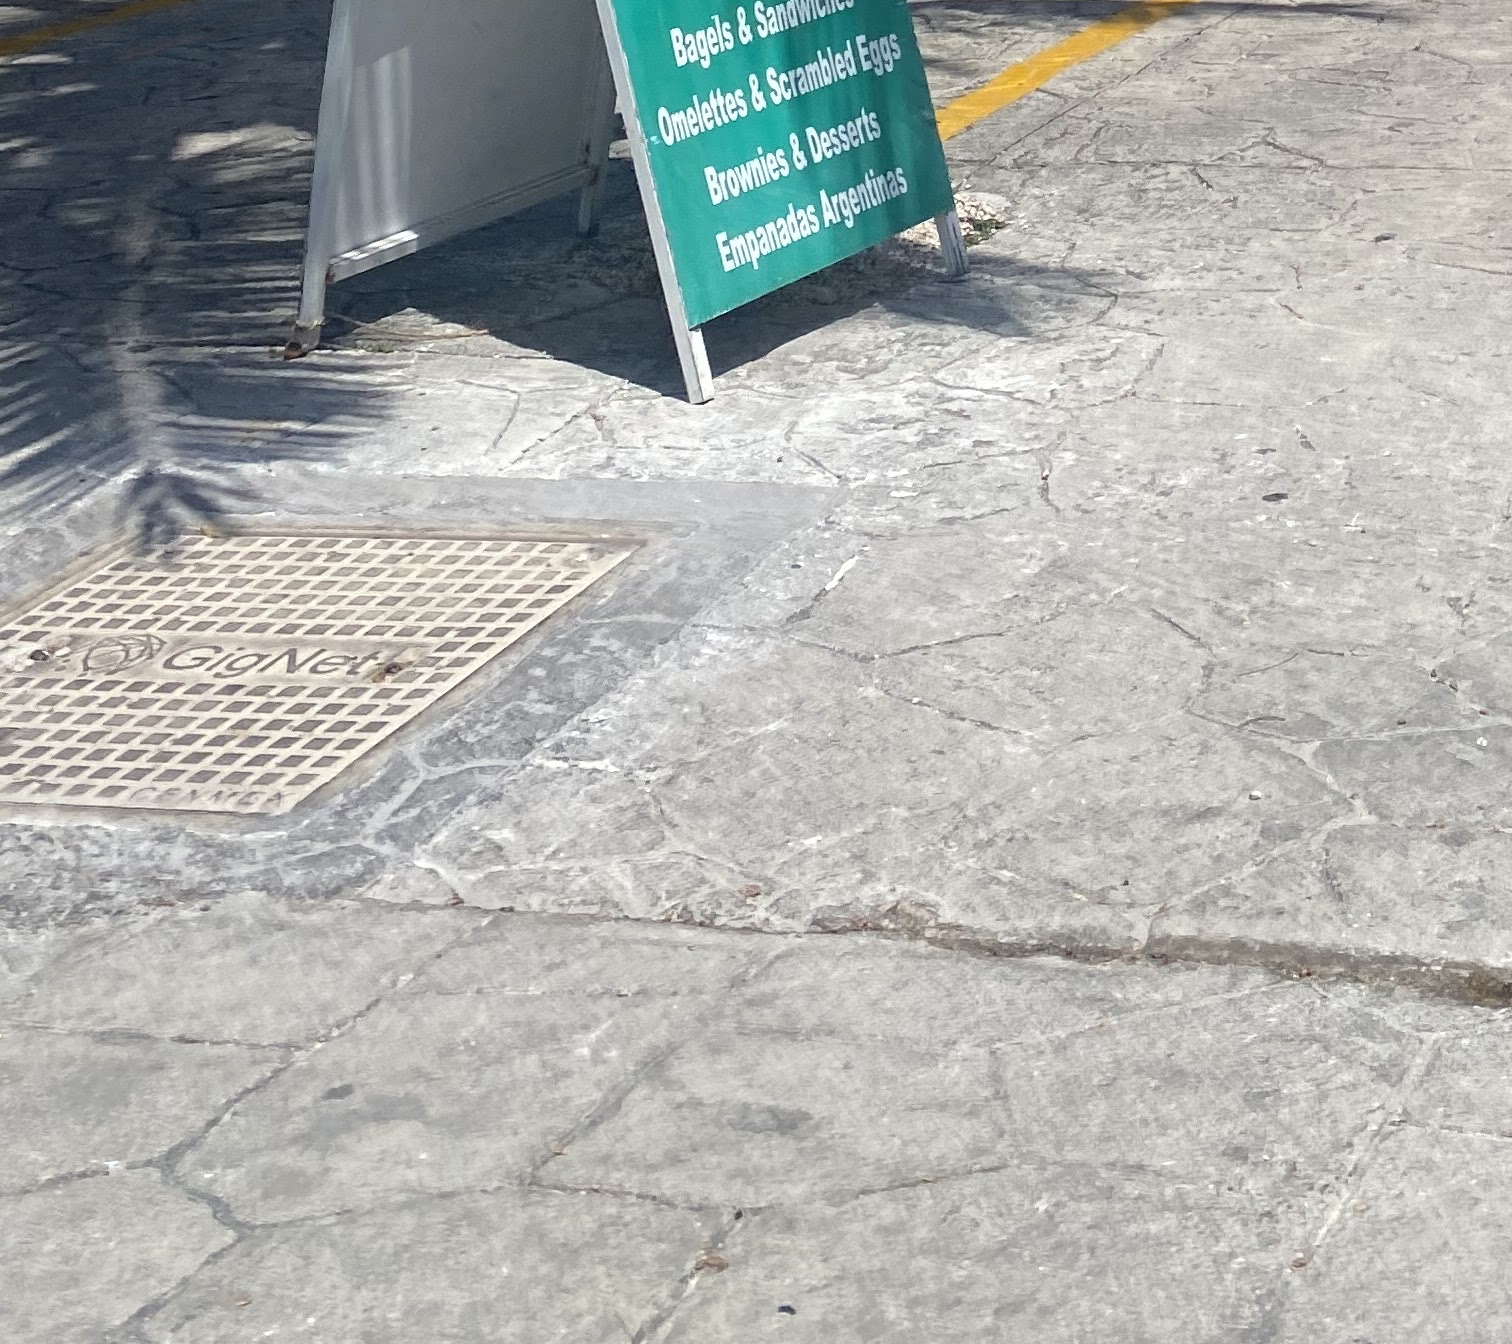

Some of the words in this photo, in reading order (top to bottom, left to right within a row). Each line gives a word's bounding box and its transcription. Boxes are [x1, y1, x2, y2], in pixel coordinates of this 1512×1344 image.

[670, 14, 735, 69] Bagels
[736, 6, 753, 45] &
[657, 87, 748, 147] Omelettes
[748, 73, 767, 112] &
[766, 40, 854, 105] Scrambled
[856, 33, 901, 76] Eggs
[704, 146, 790, 206] Brownies
[789, 132, 808, 171] &
[806, 107, 882, 164] Desserts
[715, 203, 821, 273] Empanadas
[819, 167, 908, 229] Argentinas
[163, 644, 382, 679] GigNet
